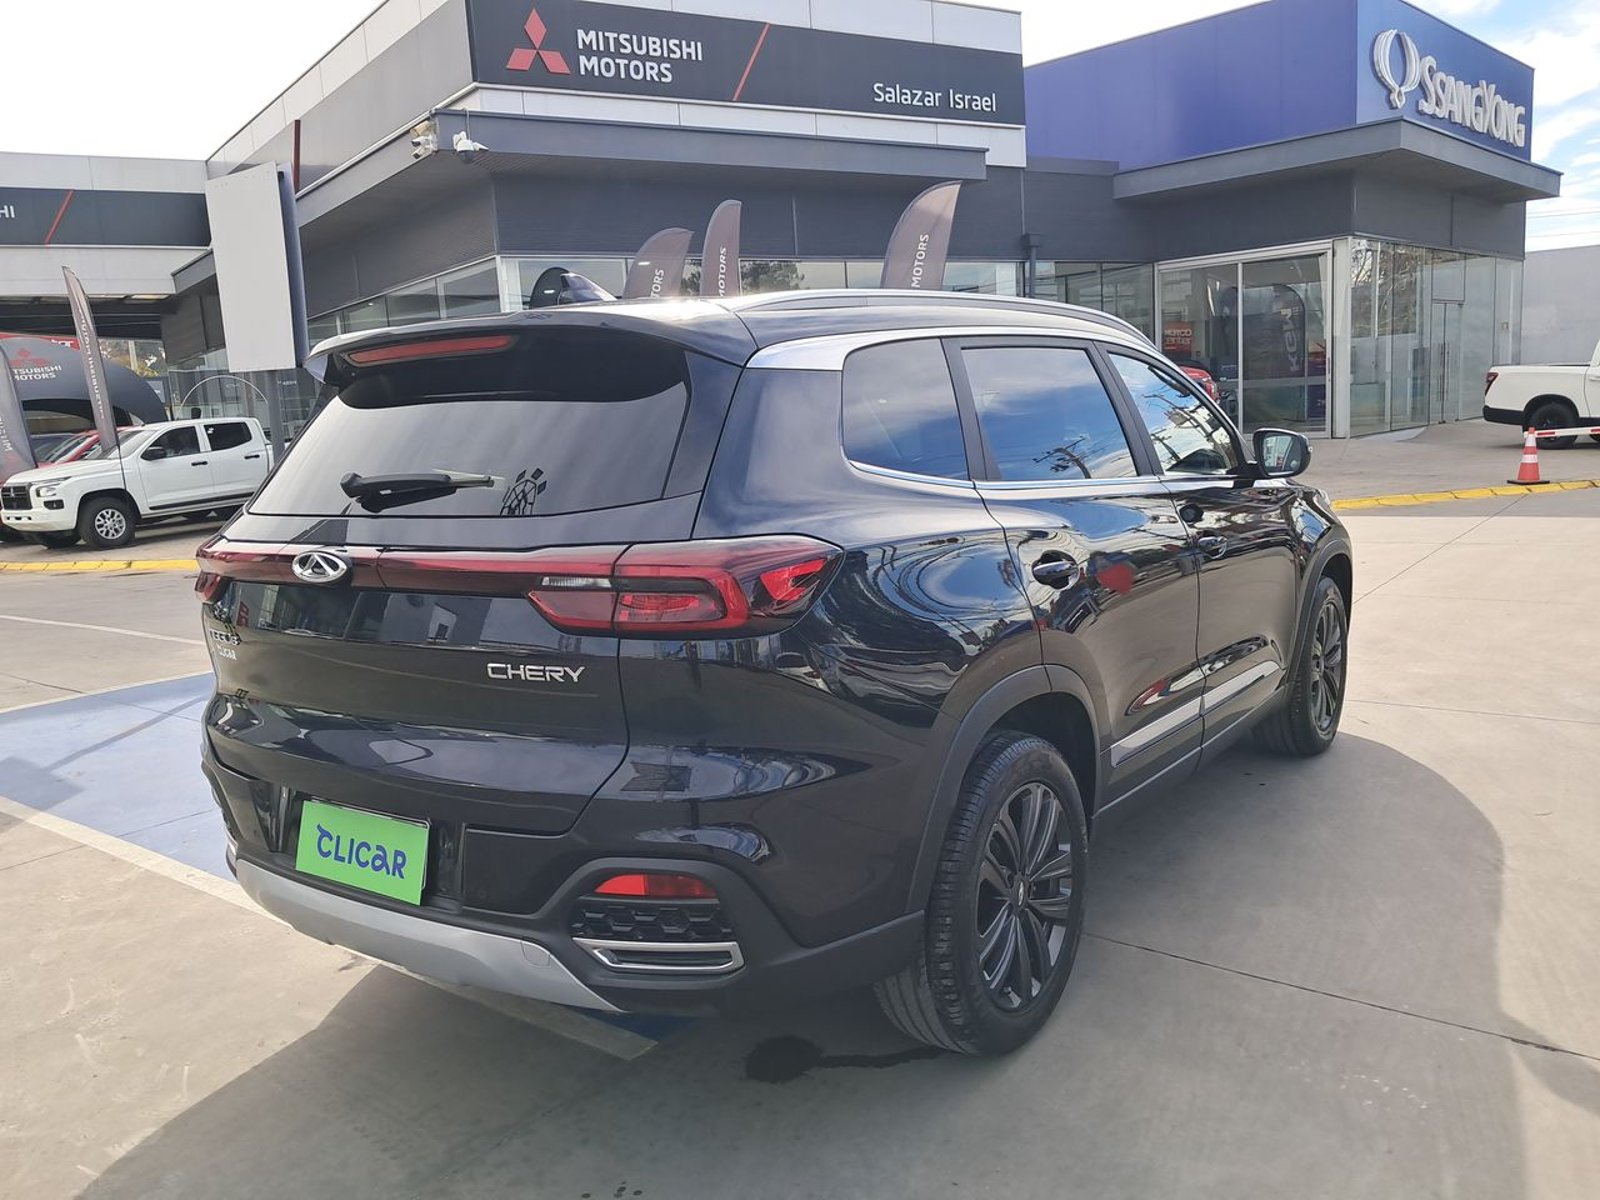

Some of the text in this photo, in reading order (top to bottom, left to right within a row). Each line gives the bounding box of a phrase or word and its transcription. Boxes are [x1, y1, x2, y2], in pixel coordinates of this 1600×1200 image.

[577, 29, 702, 61] MITSUBISHI
[579, 55, 672, 83] MOTORS
[873, 83, 996, 112] Salazar Israel
[911, 234, 929, 288] MOTORS
[487, 663, 585, 682] CHERY
